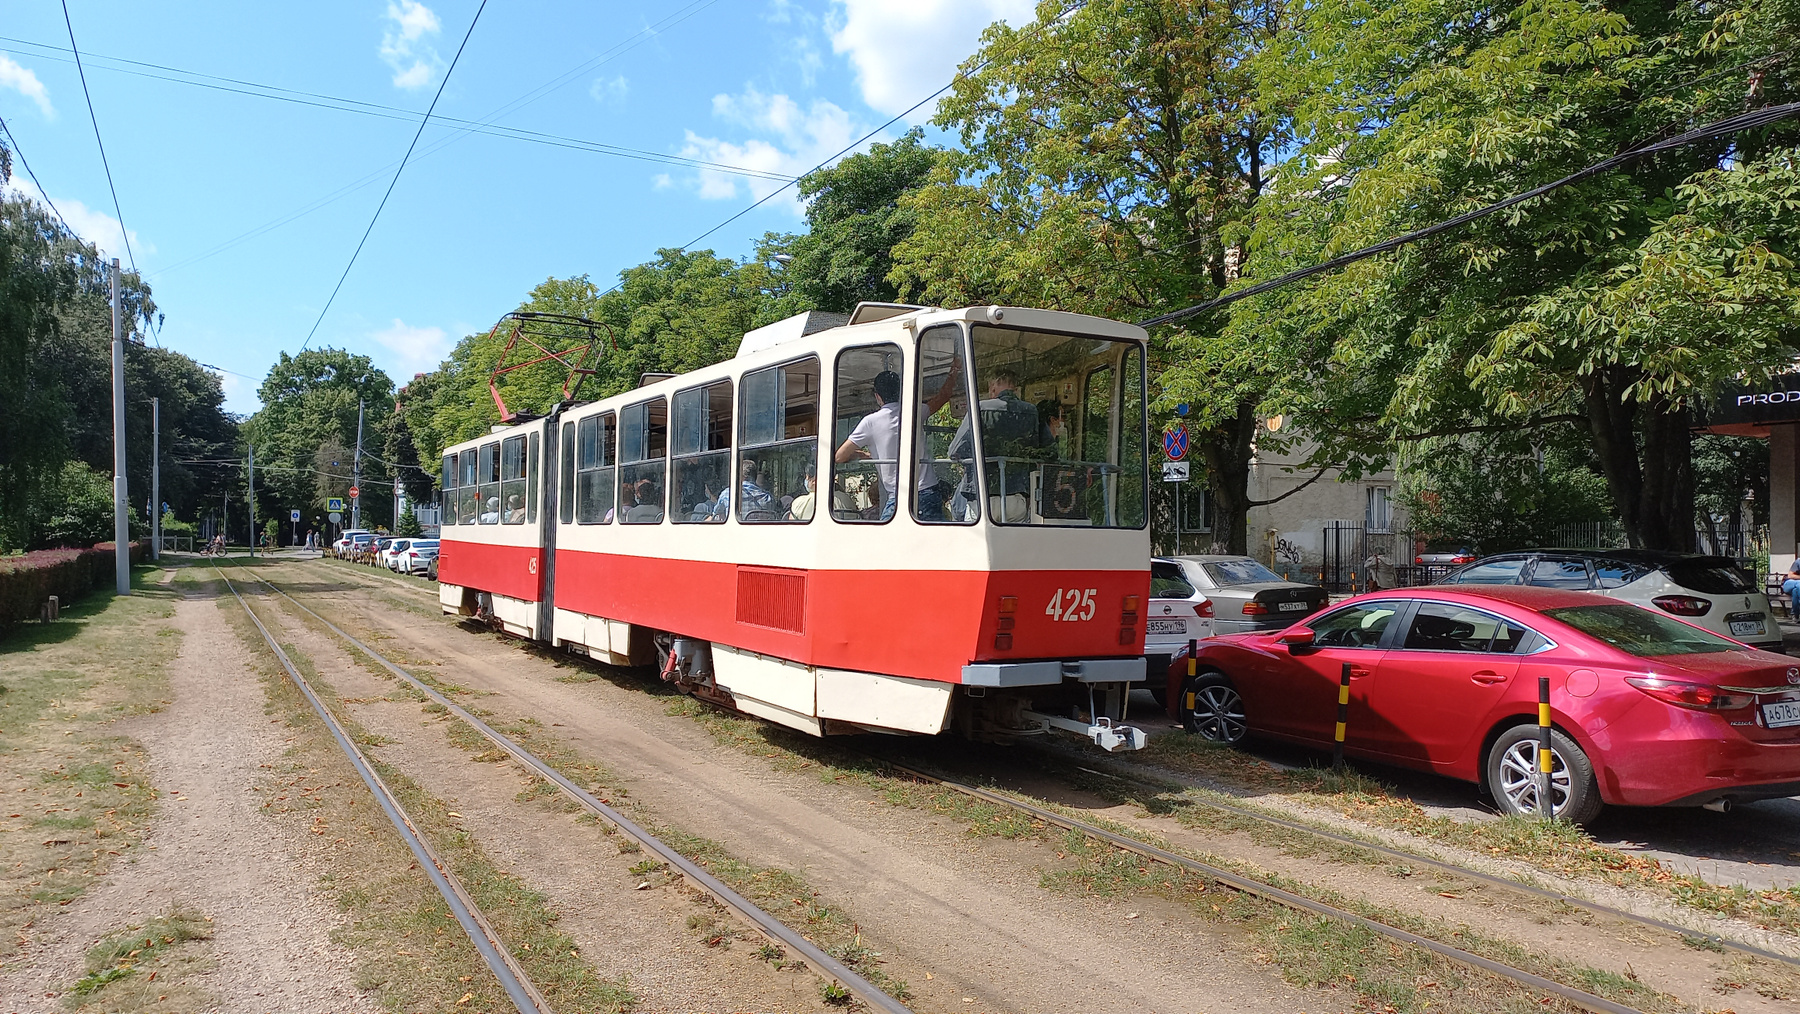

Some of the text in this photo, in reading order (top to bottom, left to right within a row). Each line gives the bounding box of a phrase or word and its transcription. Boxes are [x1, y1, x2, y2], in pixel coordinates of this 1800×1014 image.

[1054, 471, 1077, 514] 5
[1045, 588, 1097, 622] 425
[1769, 705, 1800, 721] А678С
